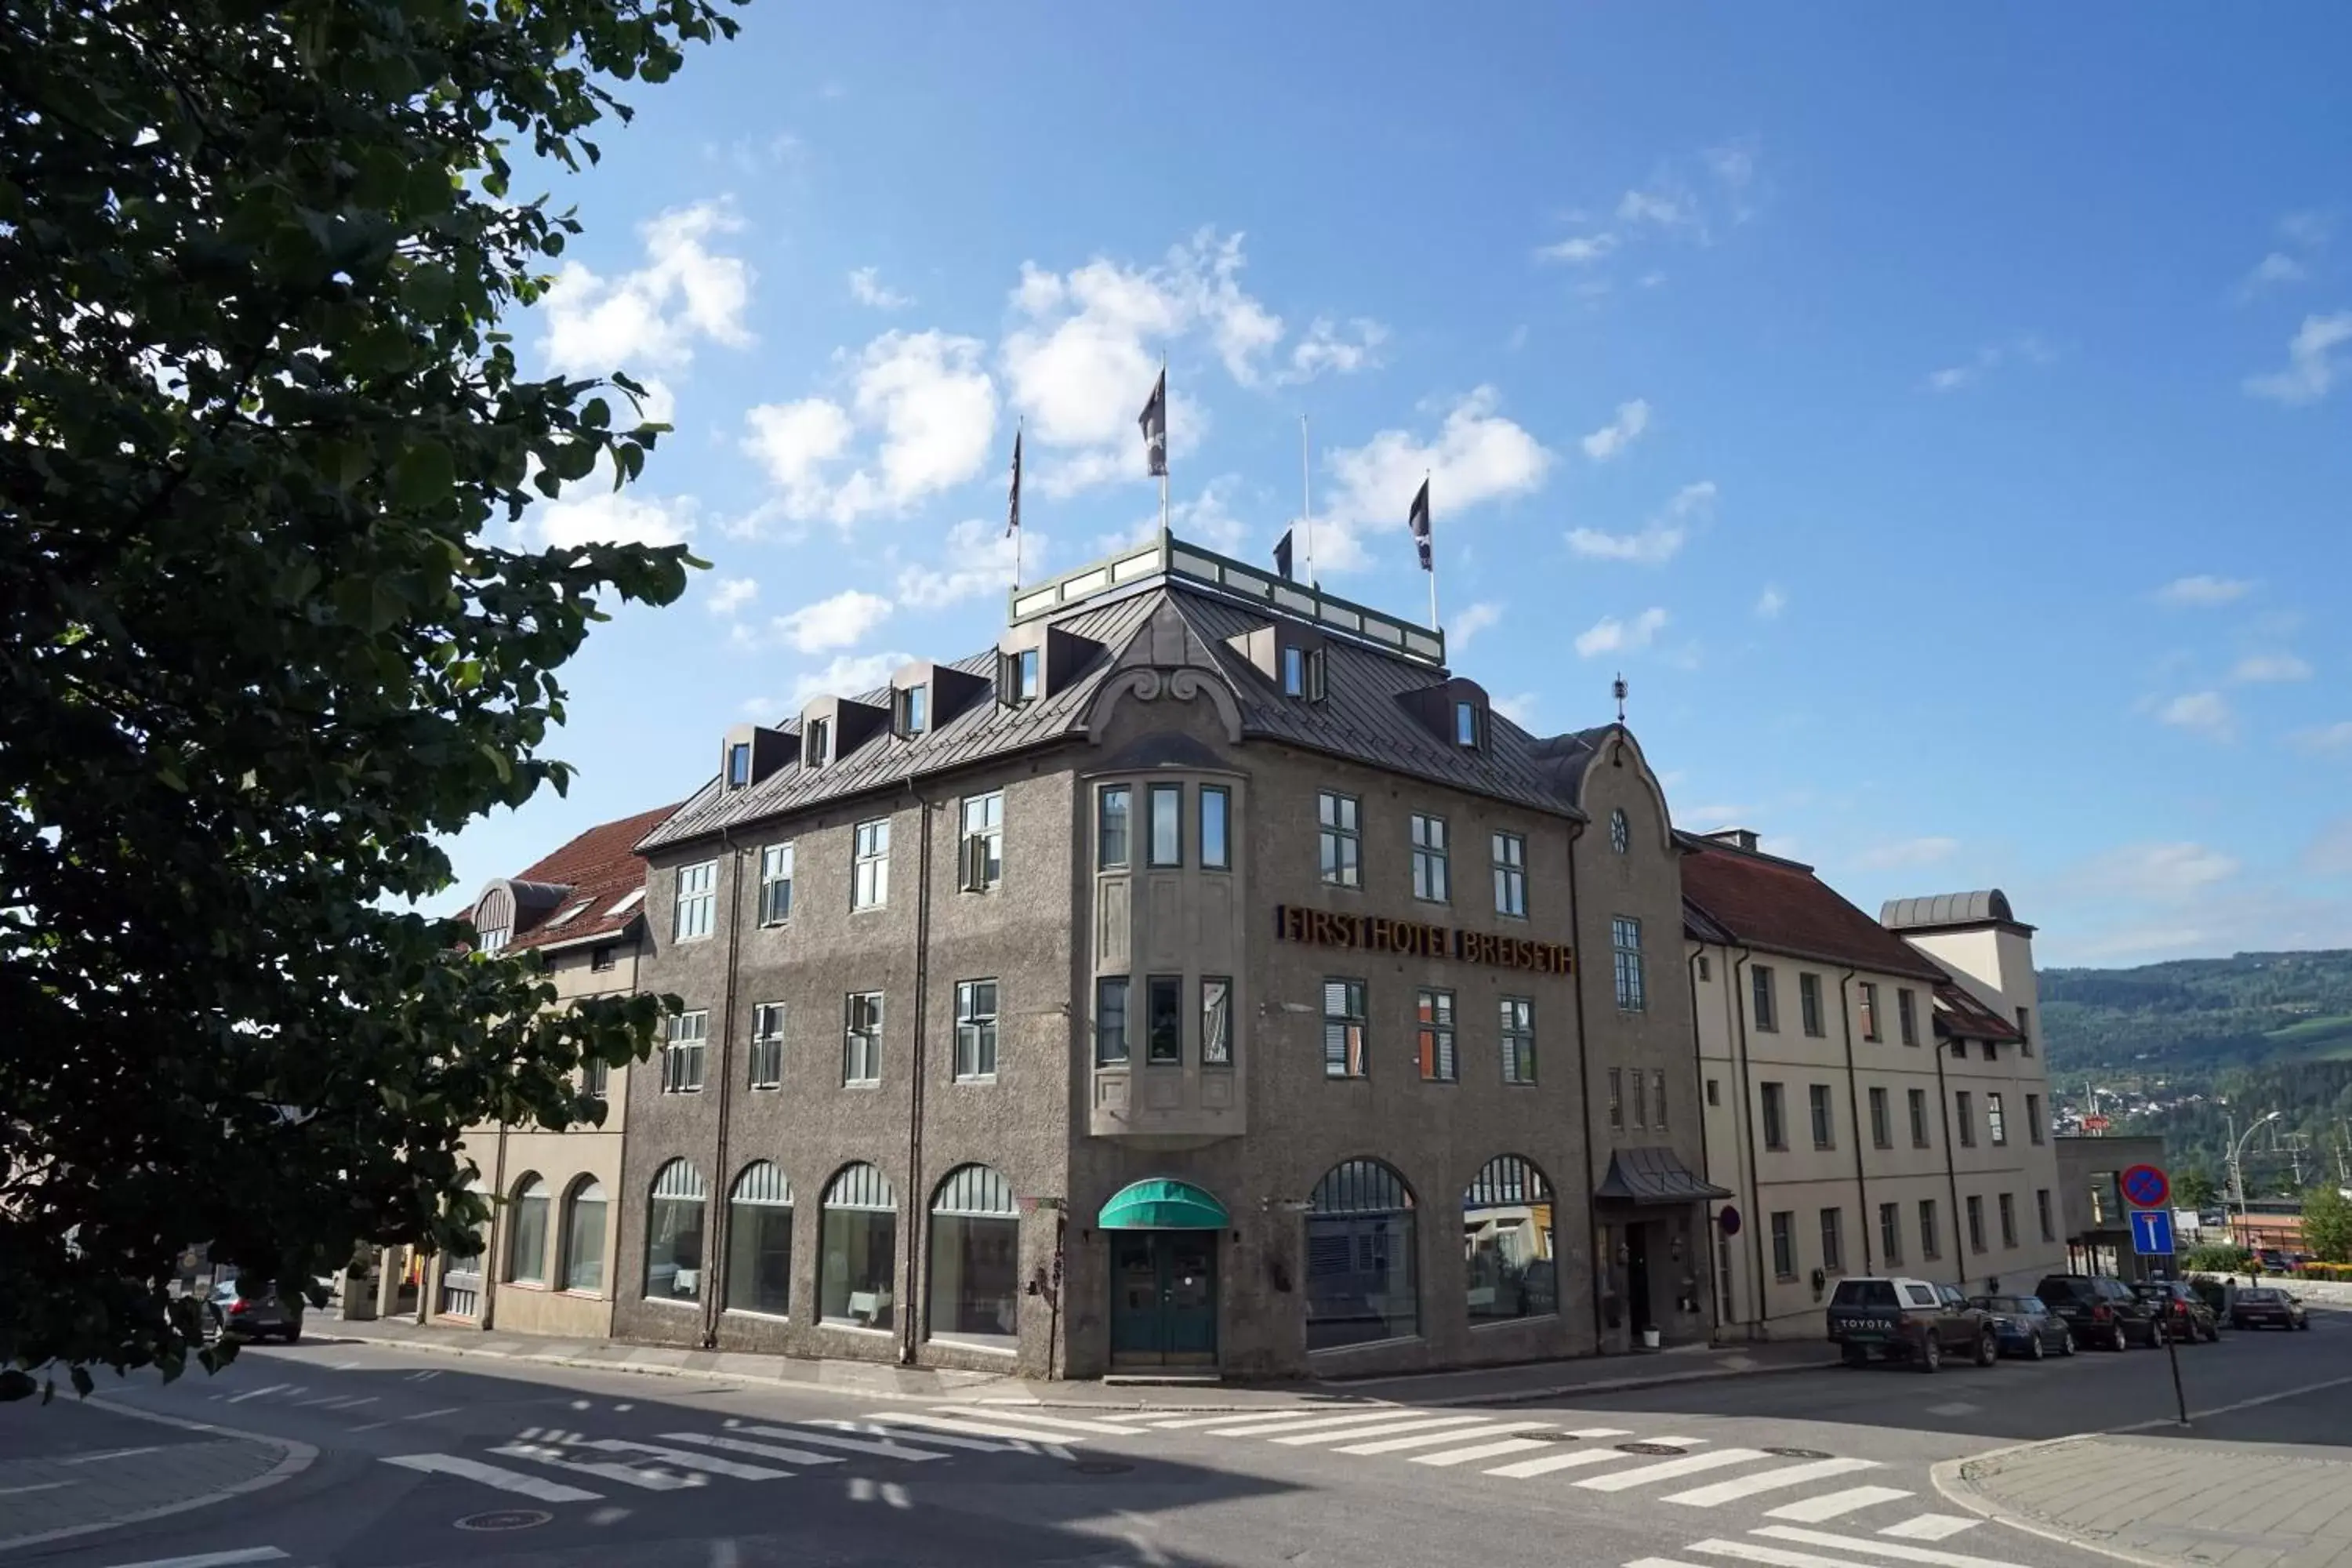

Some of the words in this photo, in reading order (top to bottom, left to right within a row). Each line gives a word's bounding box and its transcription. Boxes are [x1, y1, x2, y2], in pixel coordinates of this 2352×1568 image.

[1279, 905, 1365, 949] FIRST
[1368, 914, 1455, 958] HOTEL
[1457, 930, 1576, 975] BREISETH
[1840, 1319, 1892, 1330] TOYOTA
